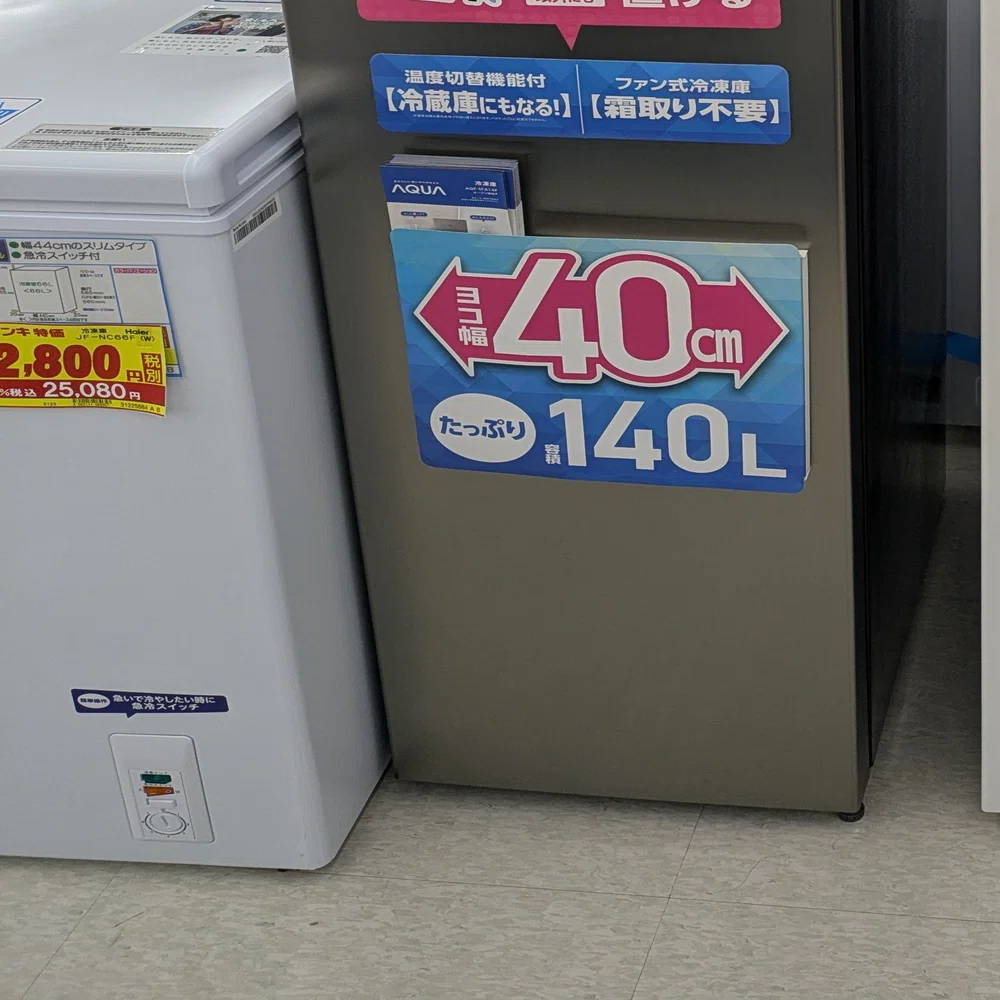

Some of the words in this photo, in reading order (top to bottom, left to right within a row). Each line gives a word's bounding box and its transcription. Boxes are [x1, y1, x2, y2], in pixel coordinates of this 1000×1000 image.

[404, 69, 547, 89] 温度切替機能付
[615, 77, 751, 95] ファン式冷凍庫
[592, 97, 780, 125] 【霜取り不要】
[391, 184, 447, 196] AQUA
[21, 240, 147, 251] 幅44cmのスリムタイプ
[24, 252, 100, 261] 急冷スイッチ付
[456, 286, 488, 347] ヨコ幅
[492, 257, 743, 376] 40cm
[33, 328, 65, 338] 特価
[144, 354, 162, 383] 税別
[438, 414, 526, 440] たっぷり
[548, 398, 787, 479] 140L
[544, 444, 562, 466] 容積
[112, 694, 216, 705] 急いで冷やしたい時に
[131, 702, 200, 711] 急冷スイッチ
